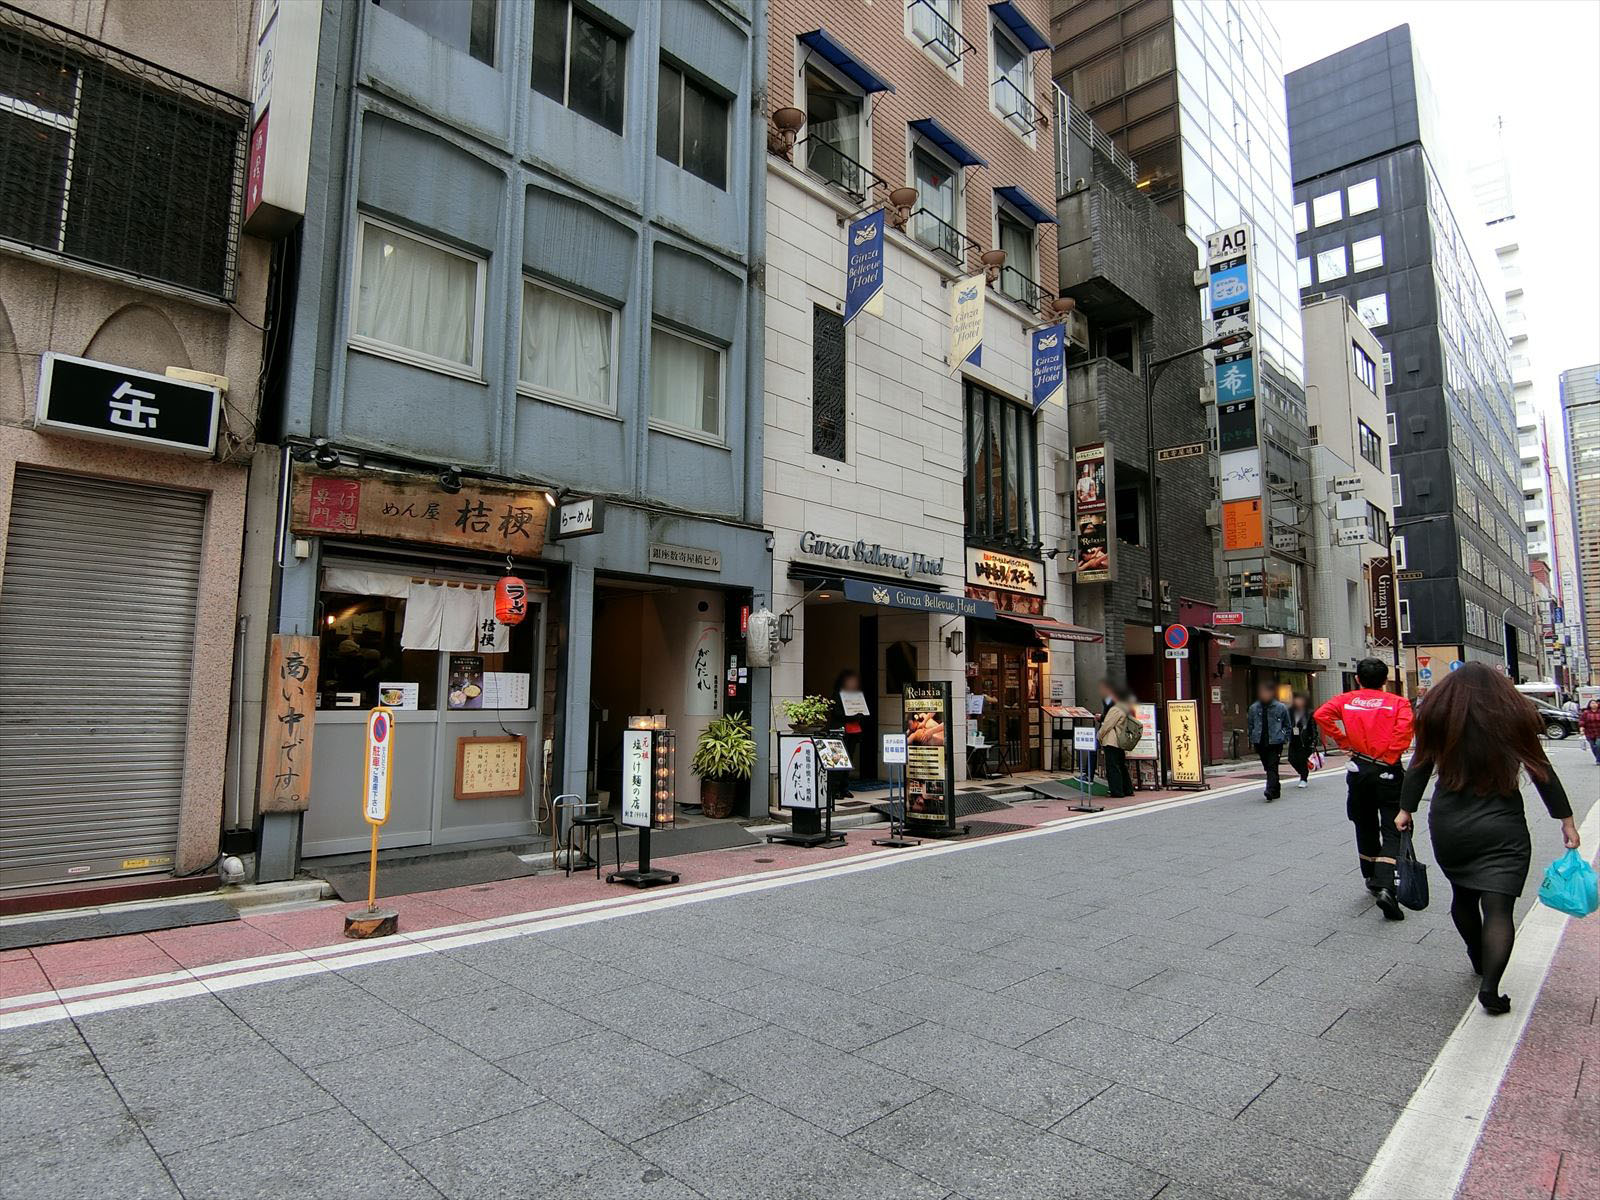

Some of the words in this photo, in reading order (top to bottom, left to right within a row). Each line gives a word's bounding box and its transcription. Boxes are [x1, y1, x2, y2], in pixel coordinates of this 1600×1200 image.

[850, 249, 879, 266] Ginza
[849, 271, 879, 293] Hotel
[954, 308, 979, 323] Ginza
[955, 328, 980, 345] Hotel
[1034, 354, 1060, 367] Ginza
[1034, 372, 1060, 388] Hotel
[1218, 366, 1247, 396] 希
[382, 502, 441, 521] めん屋
[455, 499, 533, 539] 桔梗
[561, 507, 592, 527] らーめん
[652, 548, 719, 567] 銀座数寄屋橋ビル
[800, 530, 850, 561] Ginza
[851, 537, 909, 571] Bellevue
[906, 552, 945, 578] Hotel
[1378, 574, 1390, 608] Ginza
[896, 590, 921, 606] Ginza
[924, 594, 955, 611] Bellevue
[954, 599, 977, 615] Hotel
